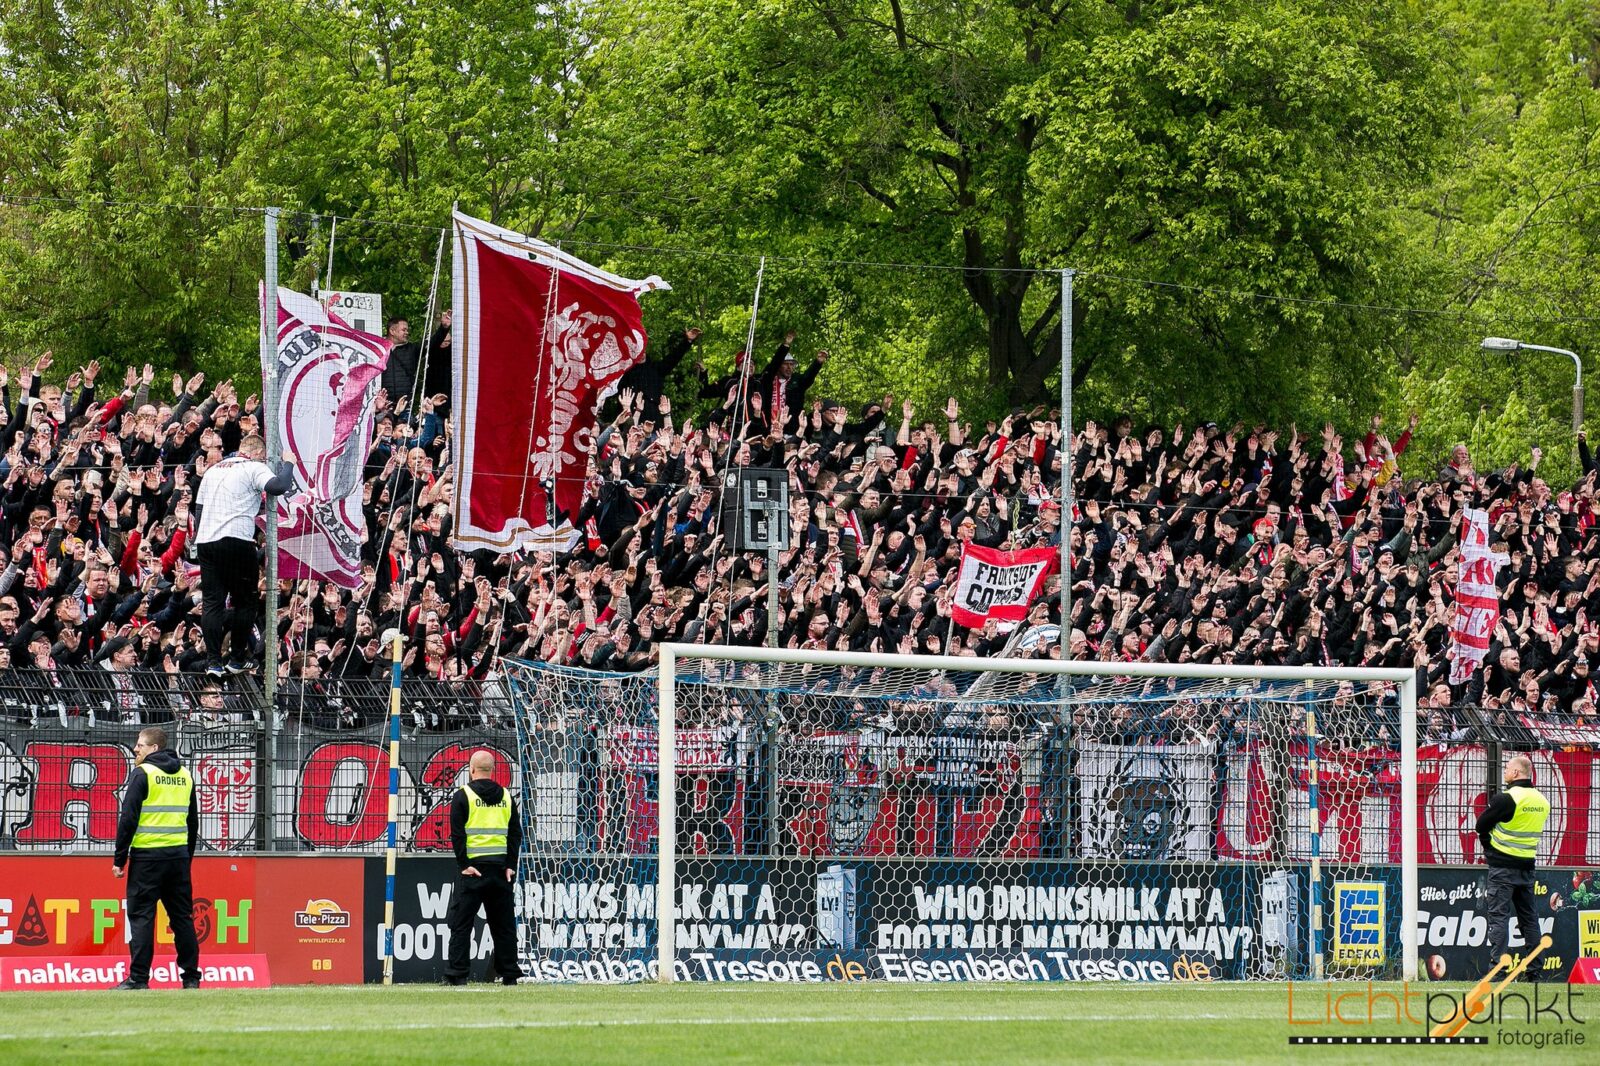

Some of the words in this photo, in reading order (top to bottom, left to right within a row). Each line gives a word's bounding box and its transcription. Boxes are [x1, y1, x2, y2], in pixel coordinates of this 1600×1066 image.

[155, 775, 187, 786] ORDNER
[709, 884, 749, 920] AT
[754, 884, 776, 920] A
[914, 884, 985, 921] WHO
[1165, 887, 1202, 922] AT
[1206, 887, 1226, 922] A
[1420, 886, 1448, 902] Hier
[1449, 881, 1483, 905] gibt's
[540, 923, 647, 948] MATCH
[657, 924, 807, 949] NYWAY?
[1117, 925, 1254, 960] ANYWAY?
[878, 953, 1050, 981] Eisenbach
[1046, 952, 1171, 981] Tresore
[1338, 948, 1381, 959] EDEKA
[13, 962, 126, 984] nahkauf
[690, 953, 822, 982] Tresore
